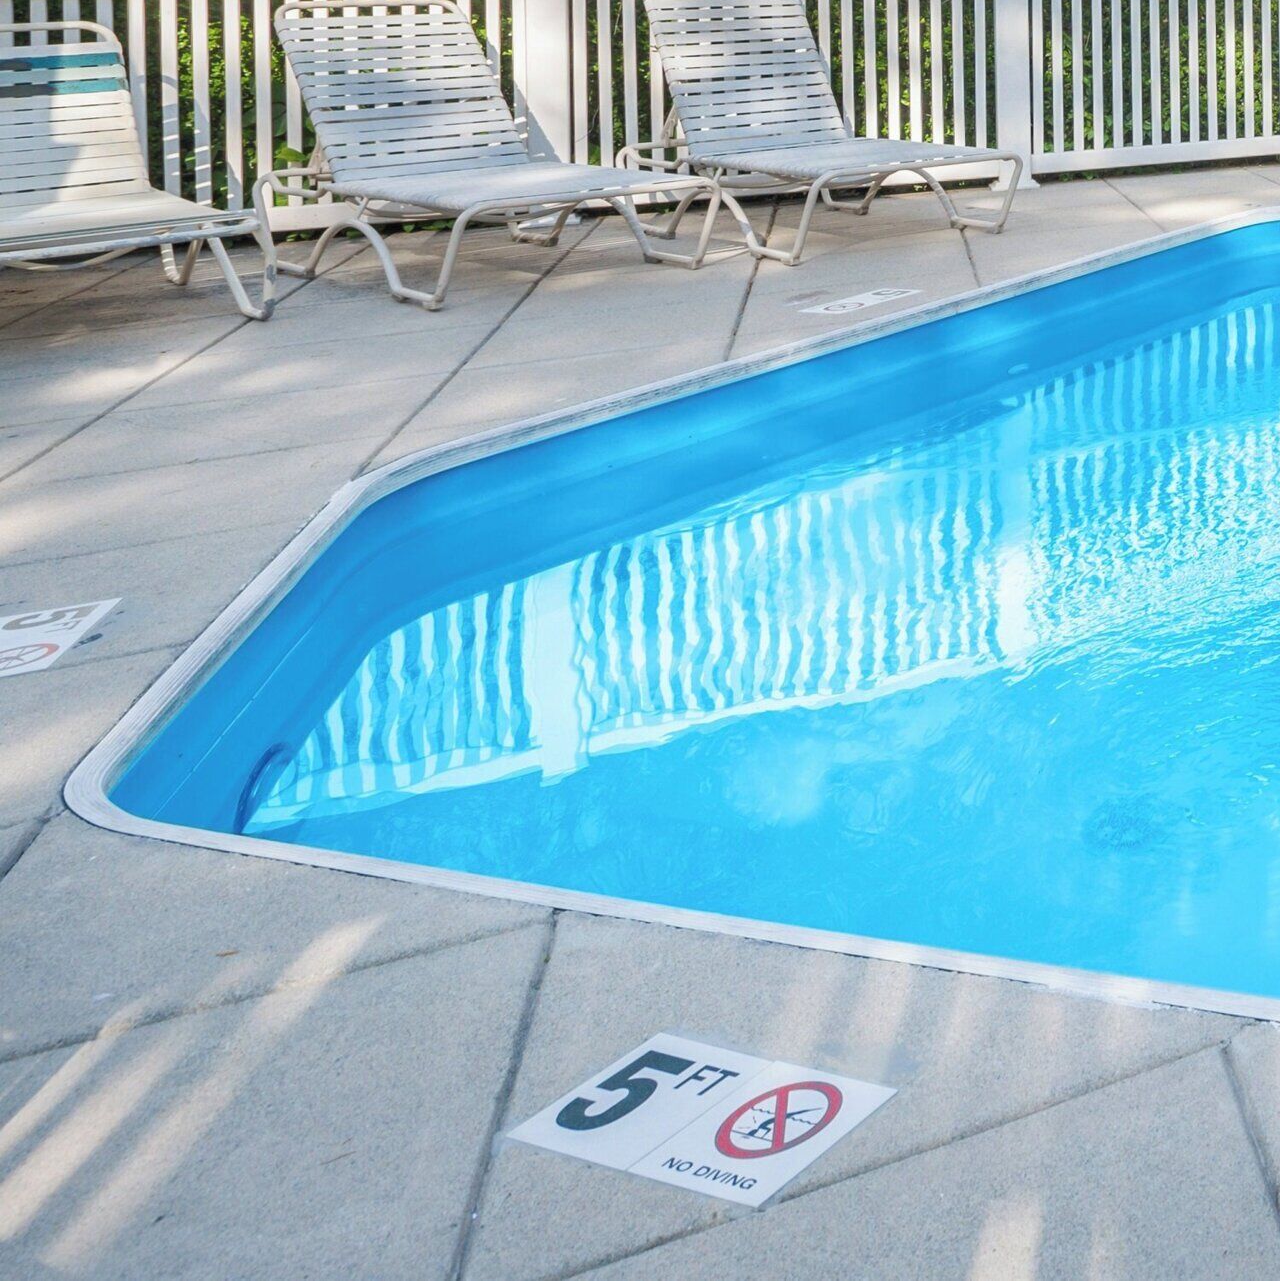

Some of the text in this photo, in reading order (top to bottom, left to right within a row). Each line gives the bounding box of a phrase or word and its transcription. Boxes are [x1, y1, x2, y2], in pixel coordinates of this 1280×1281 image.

[1, 604, 100, 631] 5
[556, 1050, 740, 1131] 5 FT
[661, 1157, 757, 1190] NO DIVING
